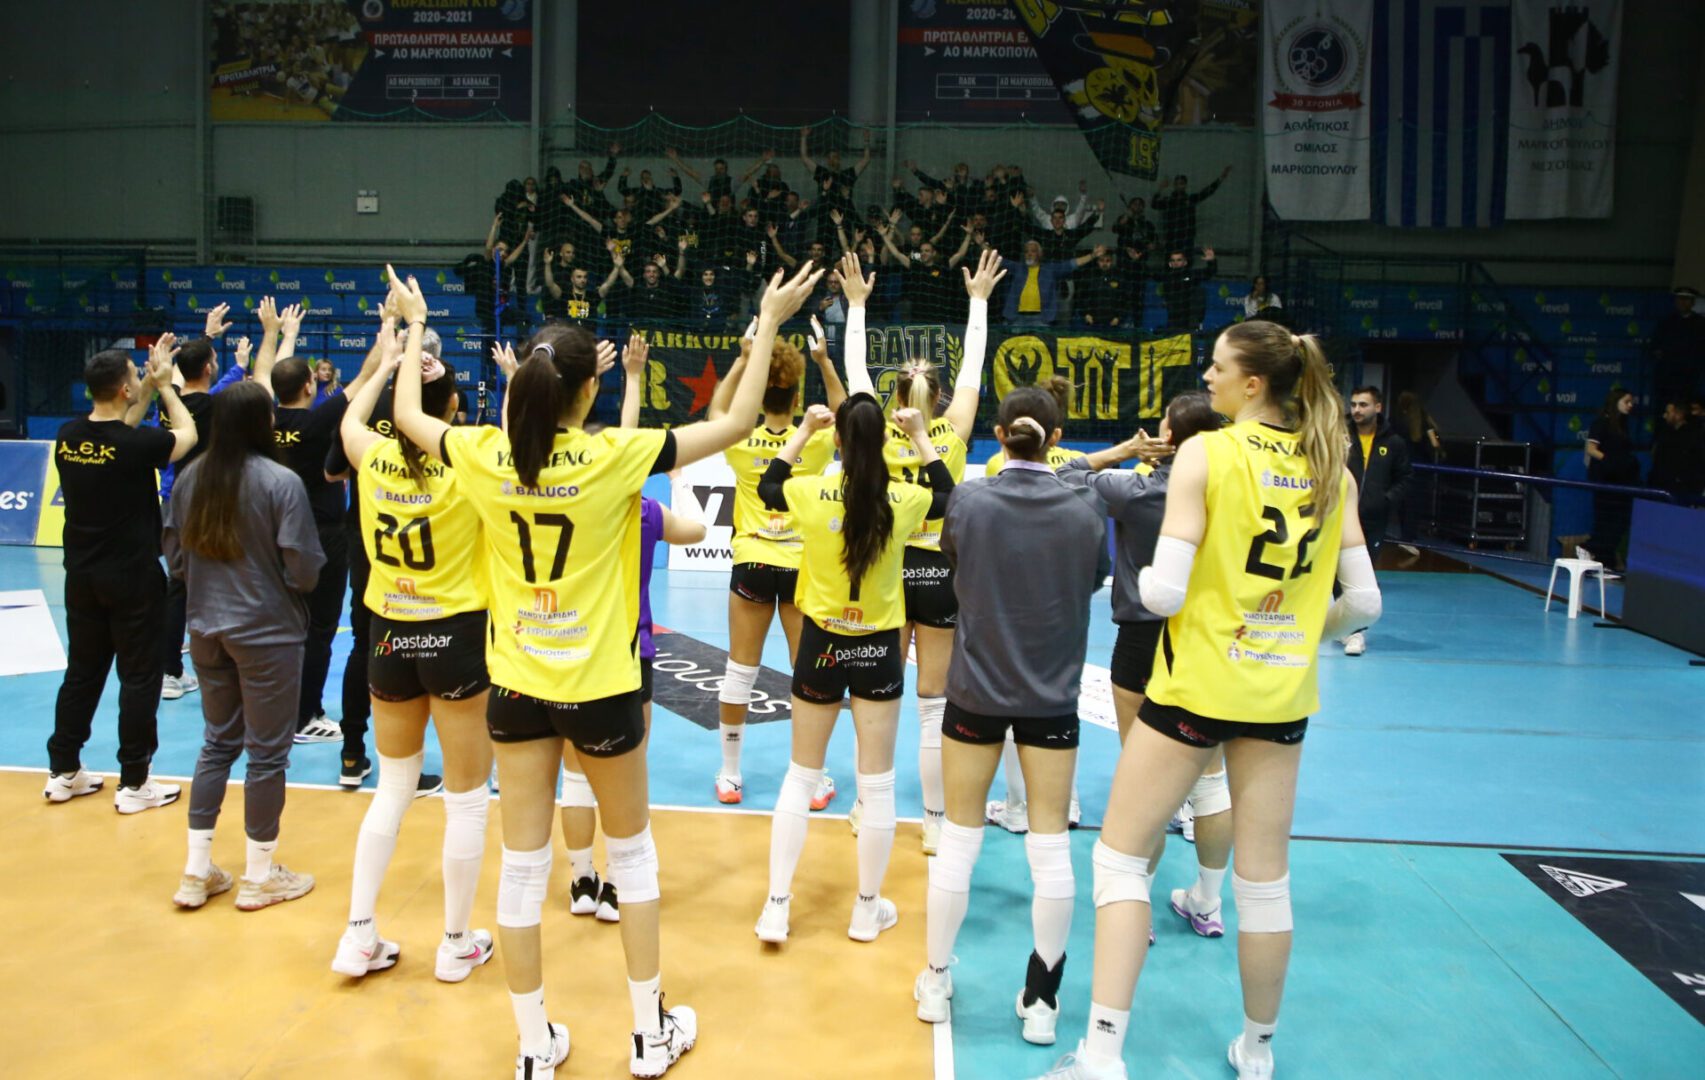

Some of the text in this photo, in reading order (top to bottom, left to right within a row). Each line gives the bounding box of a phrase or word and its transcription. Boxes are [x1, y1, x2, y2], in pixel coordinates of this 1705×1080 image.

[413, 11, 472, 22] 2020-2021
[374, 33, 513, 45] ΠΡΩΤΑΘΛΗΤΡΙΑ ΕΛΛΑΔΑΣ
[923, 31, 1014, 43] ΠΡΩΤΑΘΛΗΤΡΙΑ
[393, 48, 494, 58] ΑΟ ΜΑΡΚΟΠΟΥΛΟΥ
[943, 46, 1038, 57] ΑΟ ΜΑΡΚΟΠΟΥΛ
[1284, 120, 1350, 132] ΑΘΛΗΤΙΚΟΣ
[1294, 143, 1338, 153] ΟΜΙΛΟΣ
[1271, 164, 1358, 175] ΜΑΡΚΟΠΟΥΛΟΥ
[169, 280, 192, 290] revoil
[221, 280, 246, 290] revoil
[276, 280, 300, 291] revoil
[331, 280, 356, 291] revoil
[340, 337, 367, 348] revoil
[1592, 361, 1623, 373] revoil
[386, 491, 433, 504] BALUCO
[516, 485, 580, 498] BALUCO
[374, 511, 436, 572] 20
[510, 510, 576, 584] 17
[902, 566, 950, 580] pastabar
[392, 633, 453, 652] pastabar
[836, 644, 889, 664] pastabar
